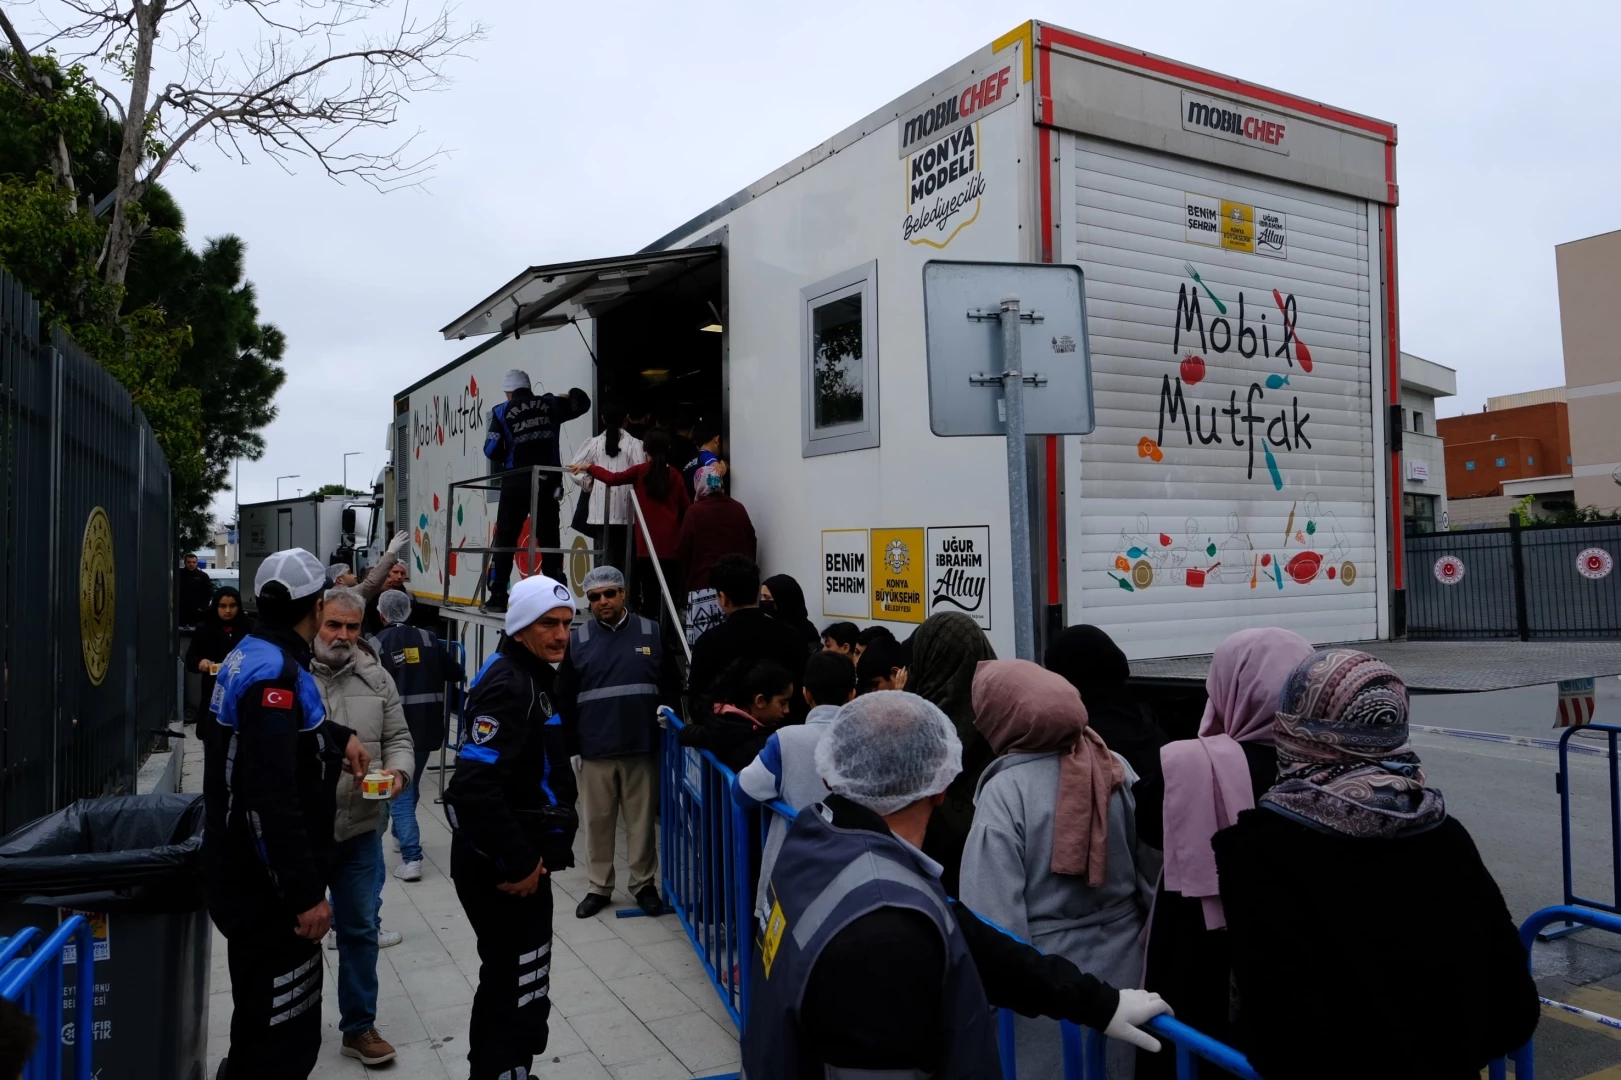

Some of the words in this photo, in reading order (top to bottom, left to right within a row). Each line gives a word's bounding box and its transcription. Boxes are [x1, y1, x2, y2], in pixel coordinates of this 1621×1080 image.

[911, 124, 975, 181] KONYA
[910, 149, 975, 206] MODELİ
[902, 171, 986, 241] Belediyecilik
[1187, 205, 1217, 221] BENİM
[1188, 219, 1217, 233] ŞEHRİM
[1257, 228, 1285, 250] Altay
[1173, 282, 1298, 368] Mobil
[413, 395, 440, 453] Mobil
[443, 385, 483, 456] Mutfak
[1157, 373, 1312, 480] Mutfak
[942, 536, 974, 553] UĞUR
[825, 553, 865, 572] BENİM
[936, 553, 982, 567] İBRAHİM
[826, 576, 866, 595] ŞEHRİM
[886, 578, 909, 589] KONYA
[932, 567, 986, 612] Altay
[875, 588, 921, 604] BÜYÜKŞEHİR
